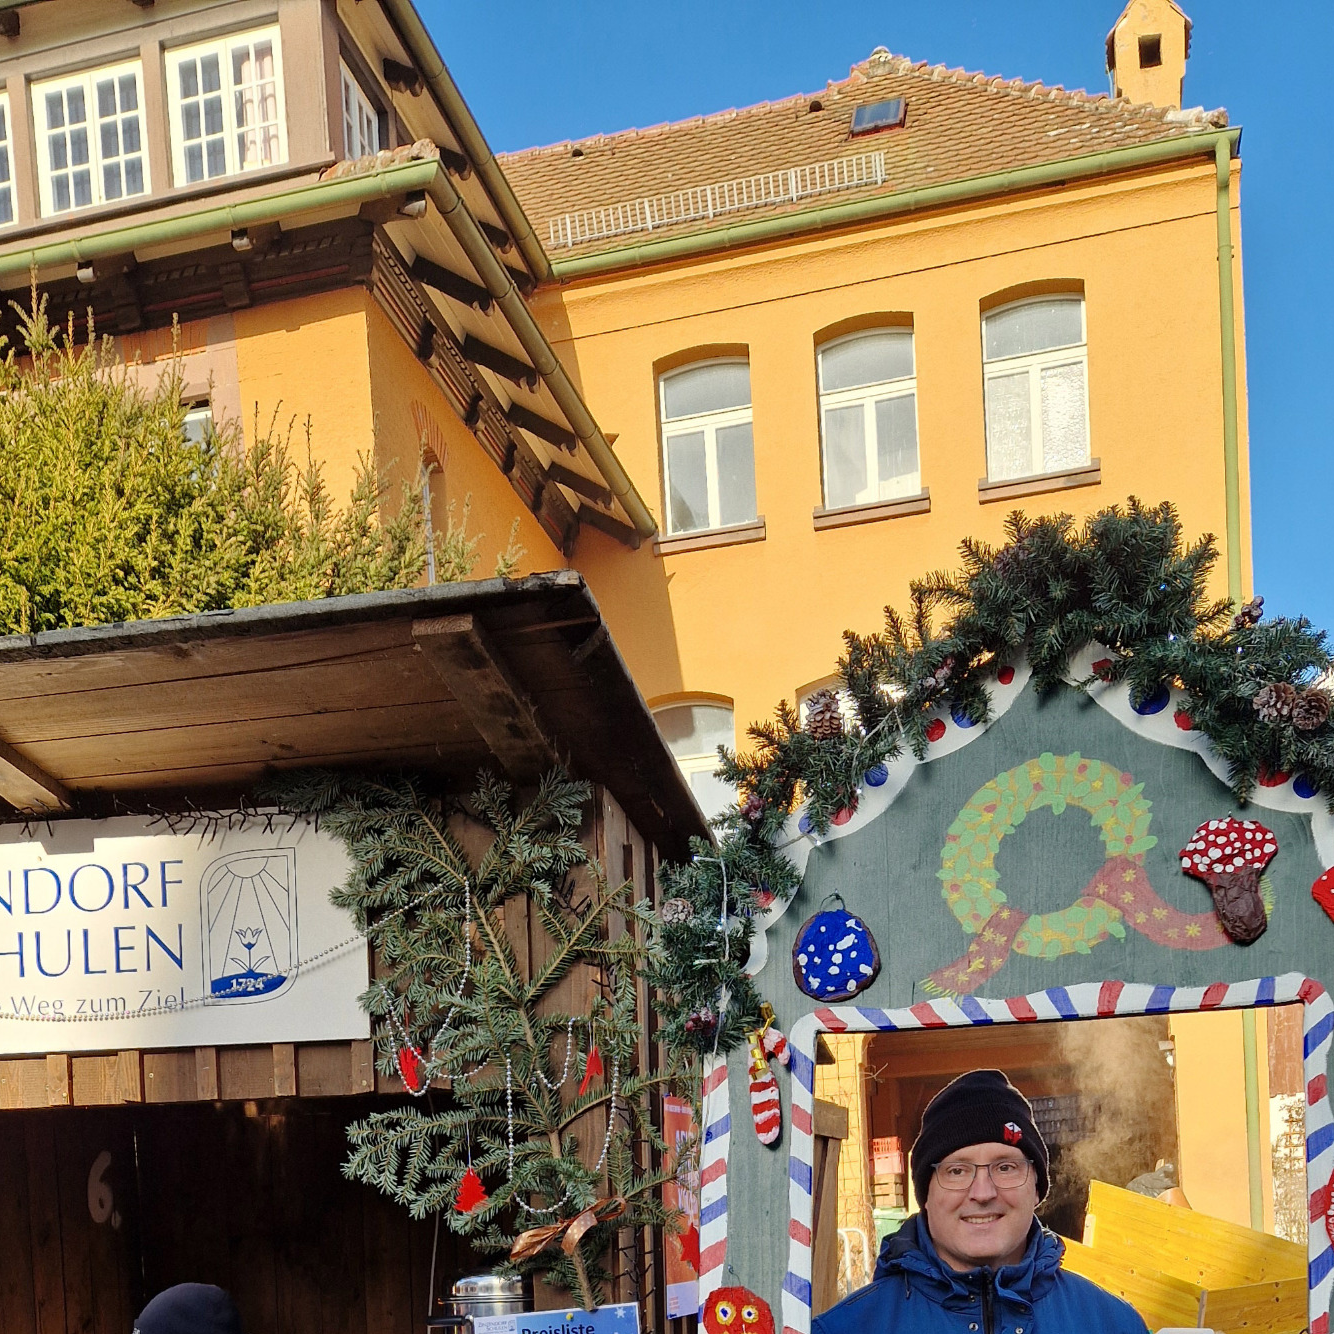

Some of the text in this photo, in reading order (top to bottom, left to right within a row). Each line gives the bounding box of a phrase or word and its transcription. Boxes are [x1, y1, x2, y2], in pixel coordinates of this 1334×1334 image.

[230, 977, 265, 992] 1724
[11, 995, 65, 1019] Weg
[76, 997, 126, 1014] zum
[138, 986, 184, 1010] Ziel
